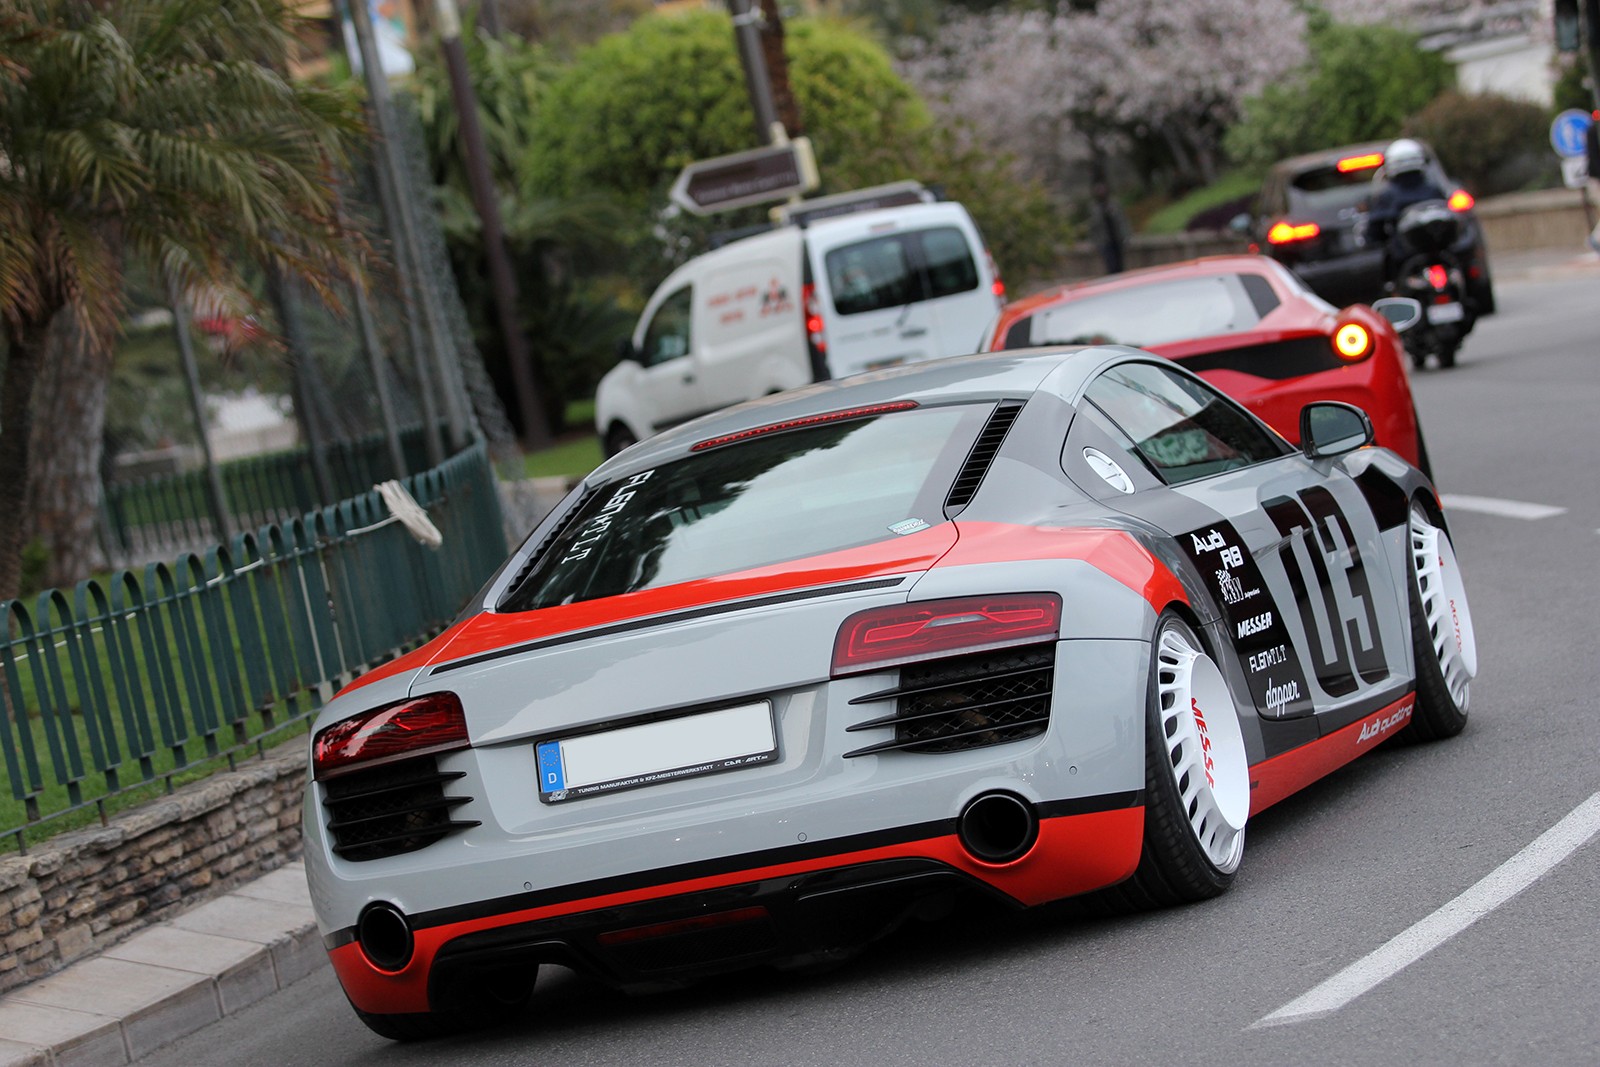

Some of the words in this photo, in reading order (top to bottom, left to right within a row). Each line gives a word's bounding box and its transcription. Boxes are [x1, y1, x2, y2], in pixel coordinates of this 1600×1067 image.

[1191, 529, 1226, 555] Audi
[1237, 611, 1273, 640] MESSER
[1356, 718, 1380, 744] Audi
[1380, 703, 1413, 734] quattro
[548, 772, 557, 784] D
[577, 785, 600, 794] TUNING
[600, 777, 639, 790] MANUFAKTUR
